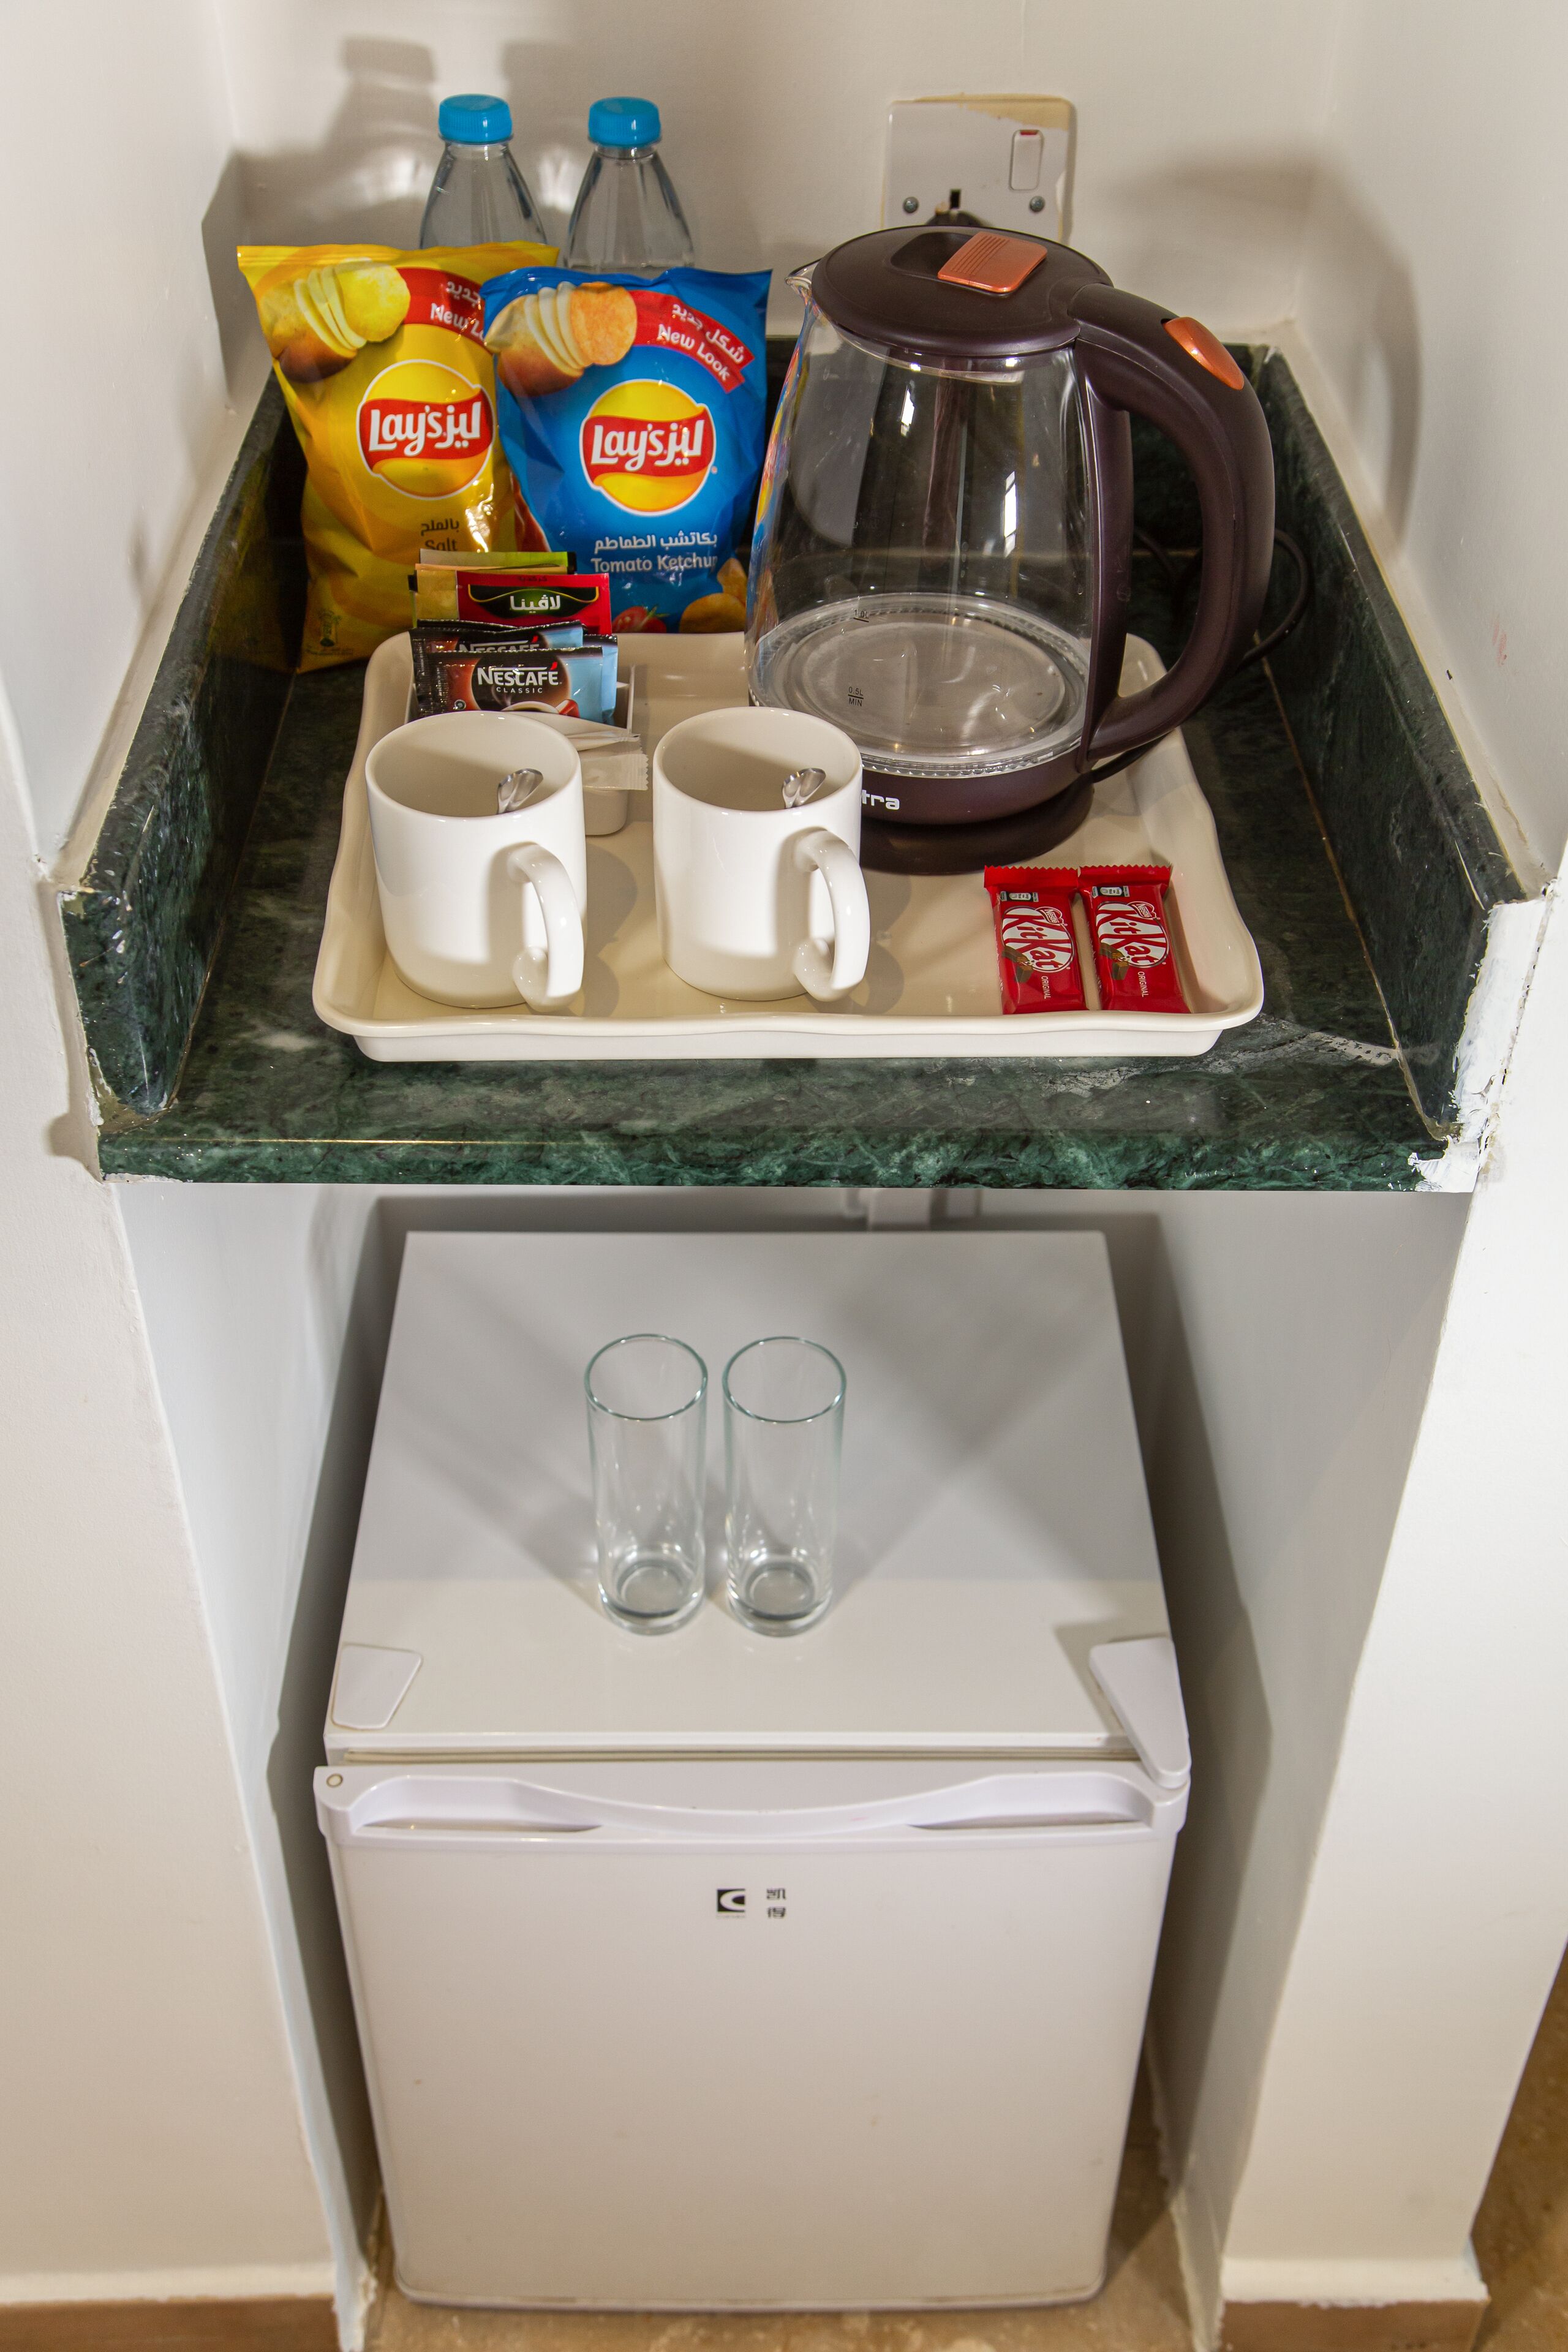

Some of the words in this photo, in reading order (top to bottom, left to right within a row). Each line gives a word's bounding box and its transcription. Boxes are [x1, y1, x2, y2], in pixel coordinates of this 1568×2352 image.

[430, 303, 469, 330] New
[673, 304, 703, 331] جديد
[658, 323, 695, 350] New
[696, 342, 730, 381] Look
[706, 329, 744, 363] شكل
[369, 405, 443, 456] Lay's
[435, 401, 482, 448] ليز
[591, 423, 664, 471] Lay's
[655, 419, 704, 466] ليز
[421, 518, 459, 537] بالملح
[660, 530, 718, 550] بكاتشب
[425, 537, 458, 551] Salt
[594, 534, 656, 554] الطماطم
[590, 558, 652, 573] Tomato
[848, 687, 864, 696] 0.5L
[848, 697, 862, 707] MIN
[1041, 975, 1052, 1000] ORIGINAL
[1138, 971, 1149, 998] ORIGINAL
